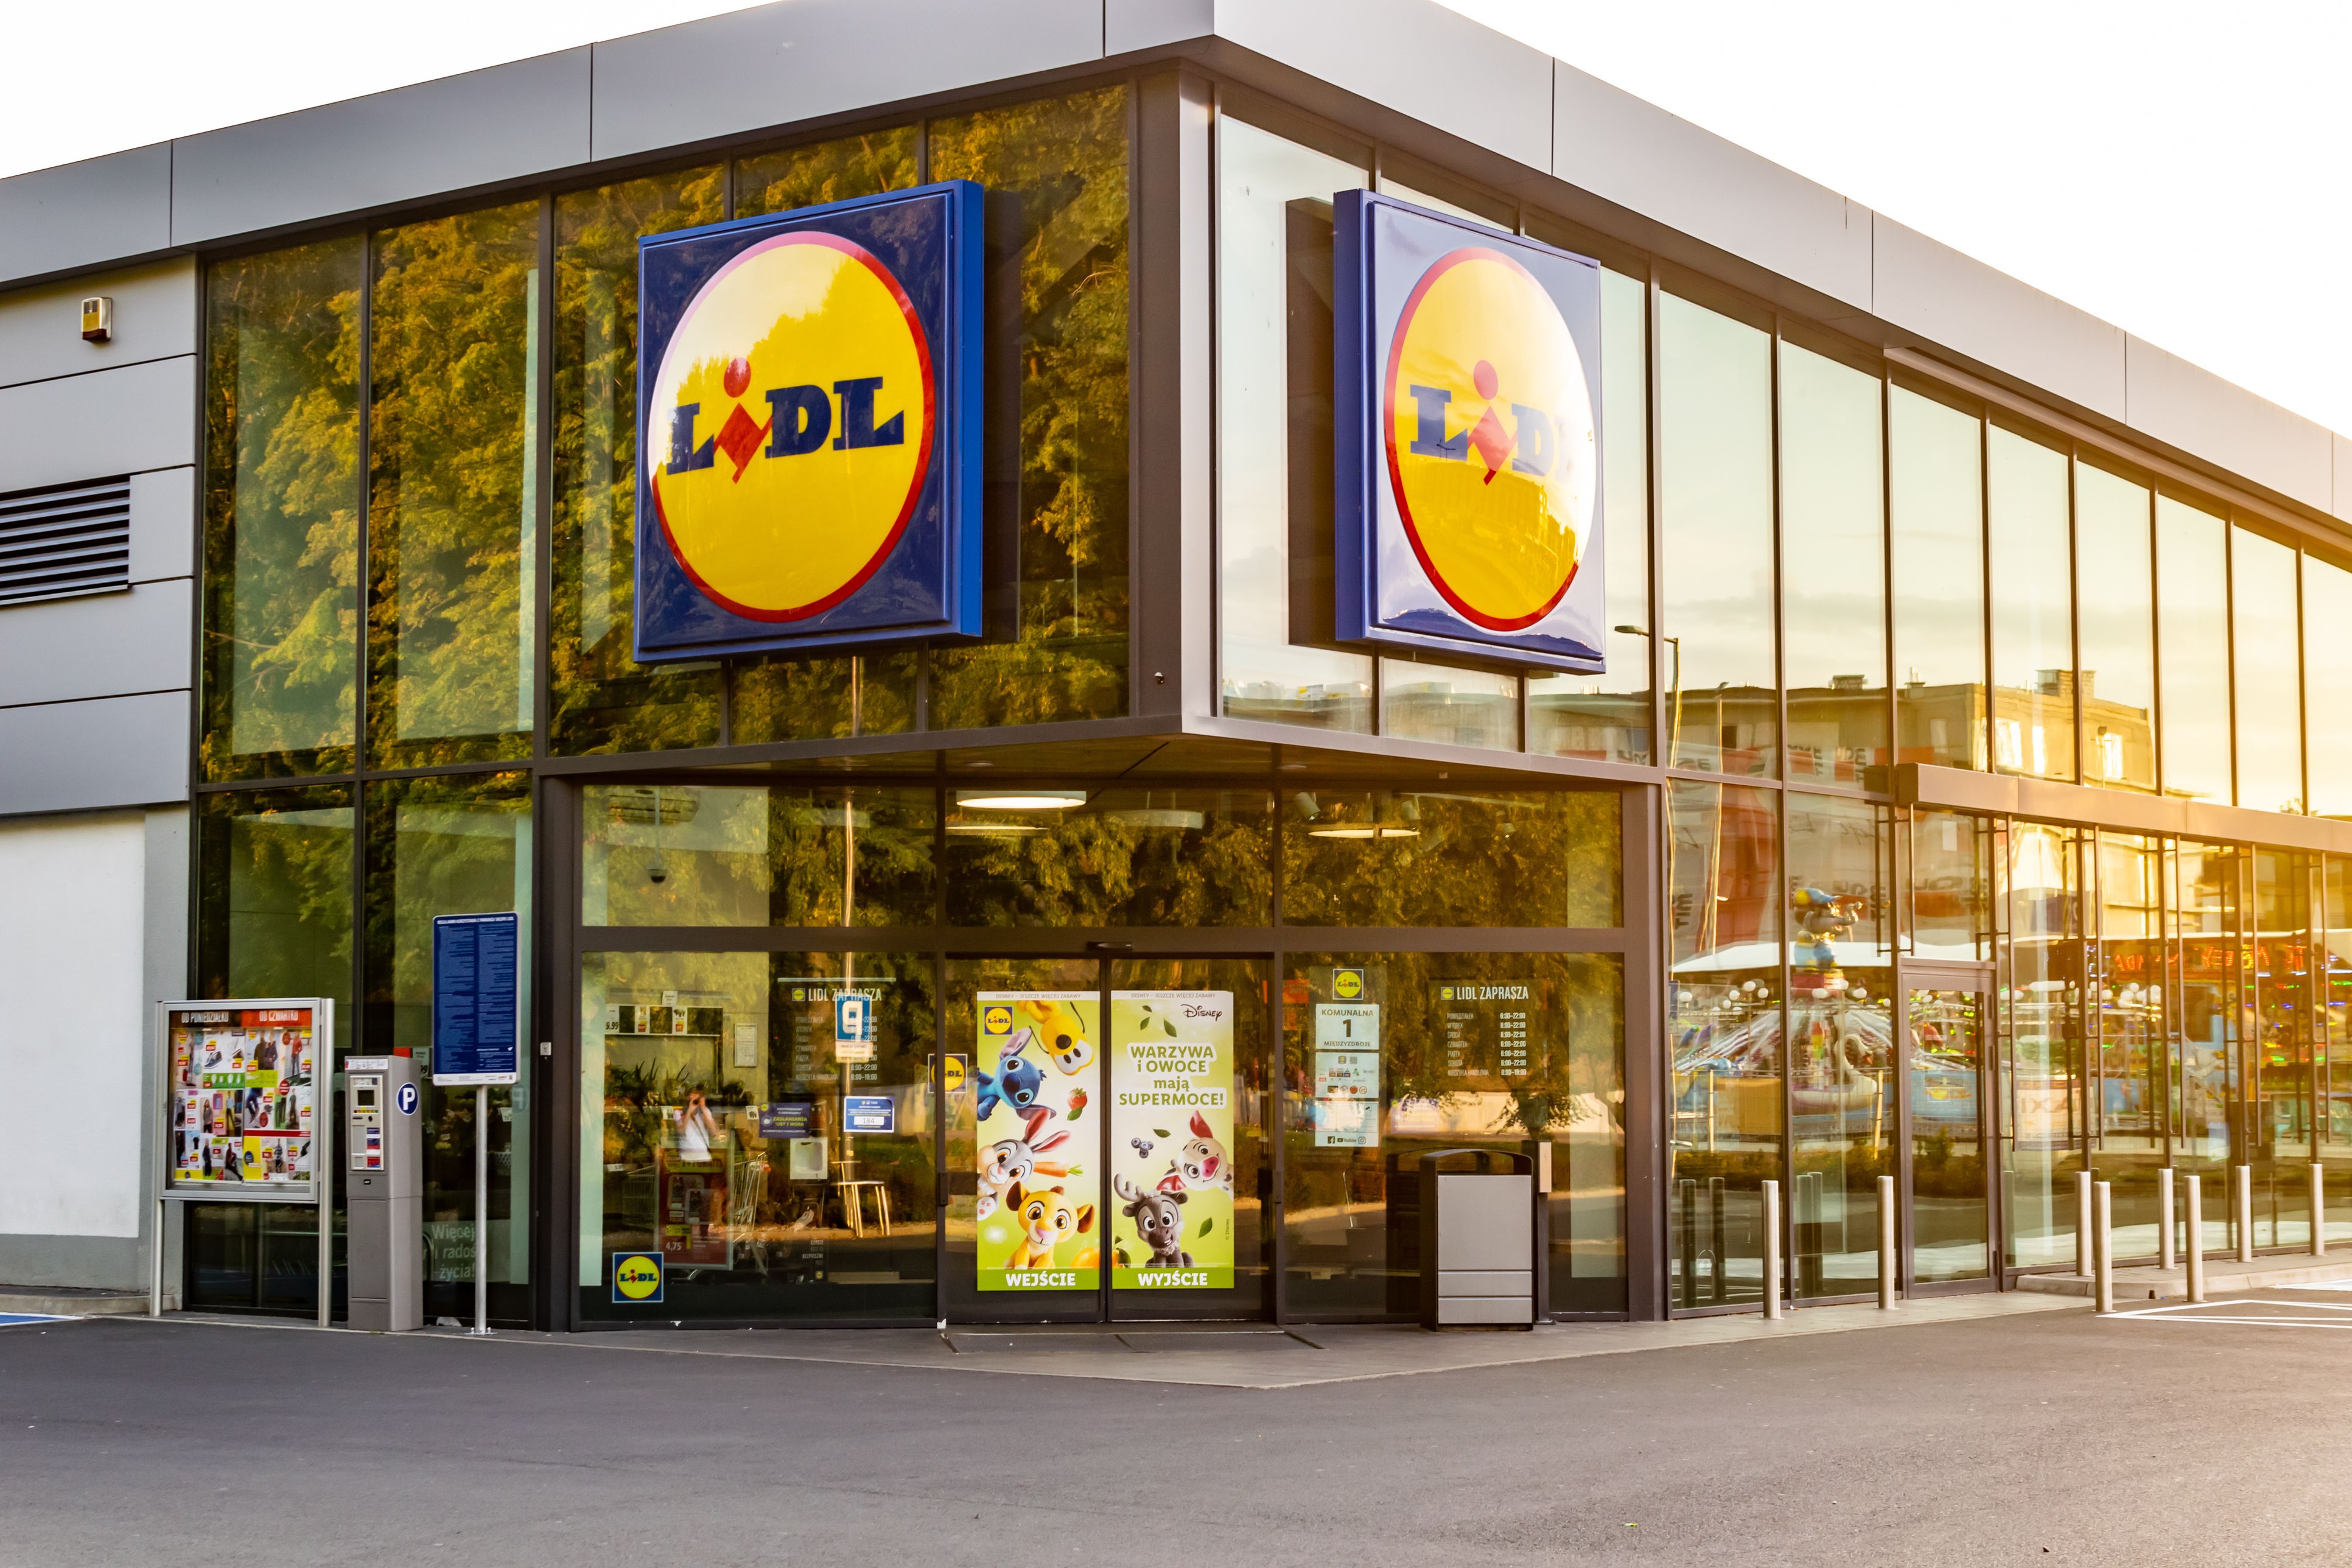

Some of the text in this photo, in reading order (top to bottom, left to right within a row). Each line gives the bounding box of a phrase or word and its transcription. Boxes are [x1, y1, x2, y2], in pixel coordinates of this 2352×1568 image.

[808, 989, 828, 1001] LIDL
[1457, 986, 1529, 1000] LIDL ZAPRASZA
[1343, 1019, 1351, 1037] 1
[1130, 1046, 1214, 1058] WARZYWA
[1138, 1060, 1206, 1073] i OWOCE
[1153, 1076, 1189, 1092] mają
[403, 1087, 415, 1111] P
[1119, 1093, 1223, 1105] SUPERMOCE!
[432, 1223, 476, 1242] Więcej
[666, 1242, 682, 1251] 4,75
[439, 1263, 476, 1282] życia!
[1006, 1270, 1076, 1287] WEJŚCIE
[1138, 1270, 1208, 1286] WYJŚCIE
